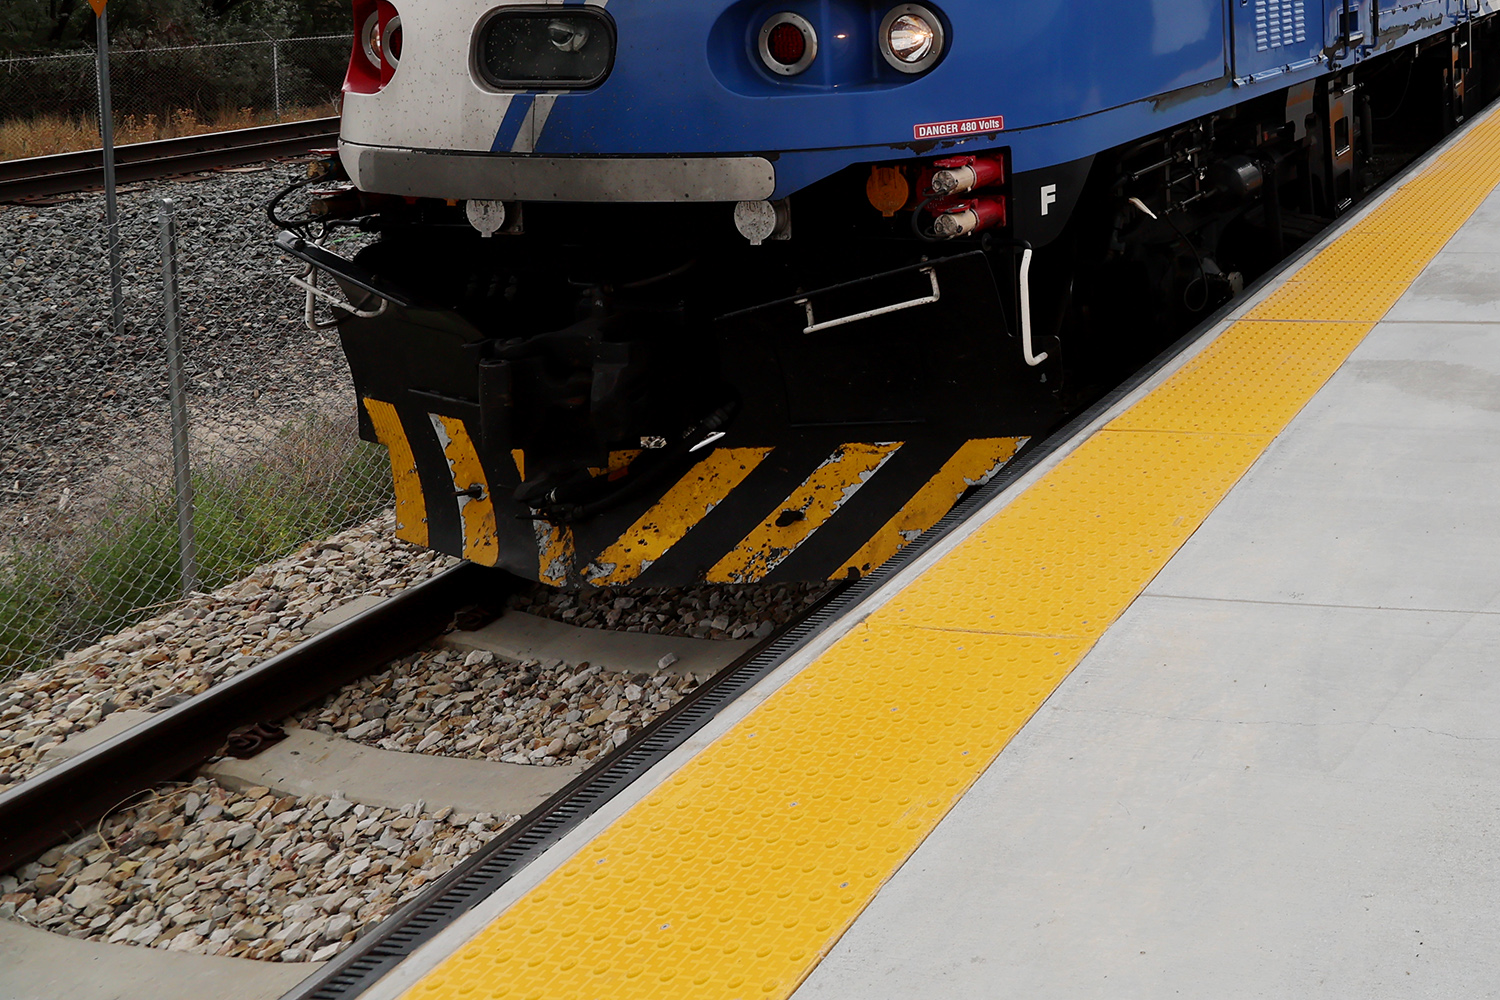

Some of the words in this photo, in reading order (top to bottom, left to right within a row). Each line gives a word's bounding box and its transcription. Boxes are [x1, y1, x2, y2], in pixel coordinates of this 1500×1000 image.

[919, 123, 959, 137] DANGER
[960, 121, 977, 132] 480
[978, 119, 1000, 130] Volts
[1040, 183, 1057, 217] F
